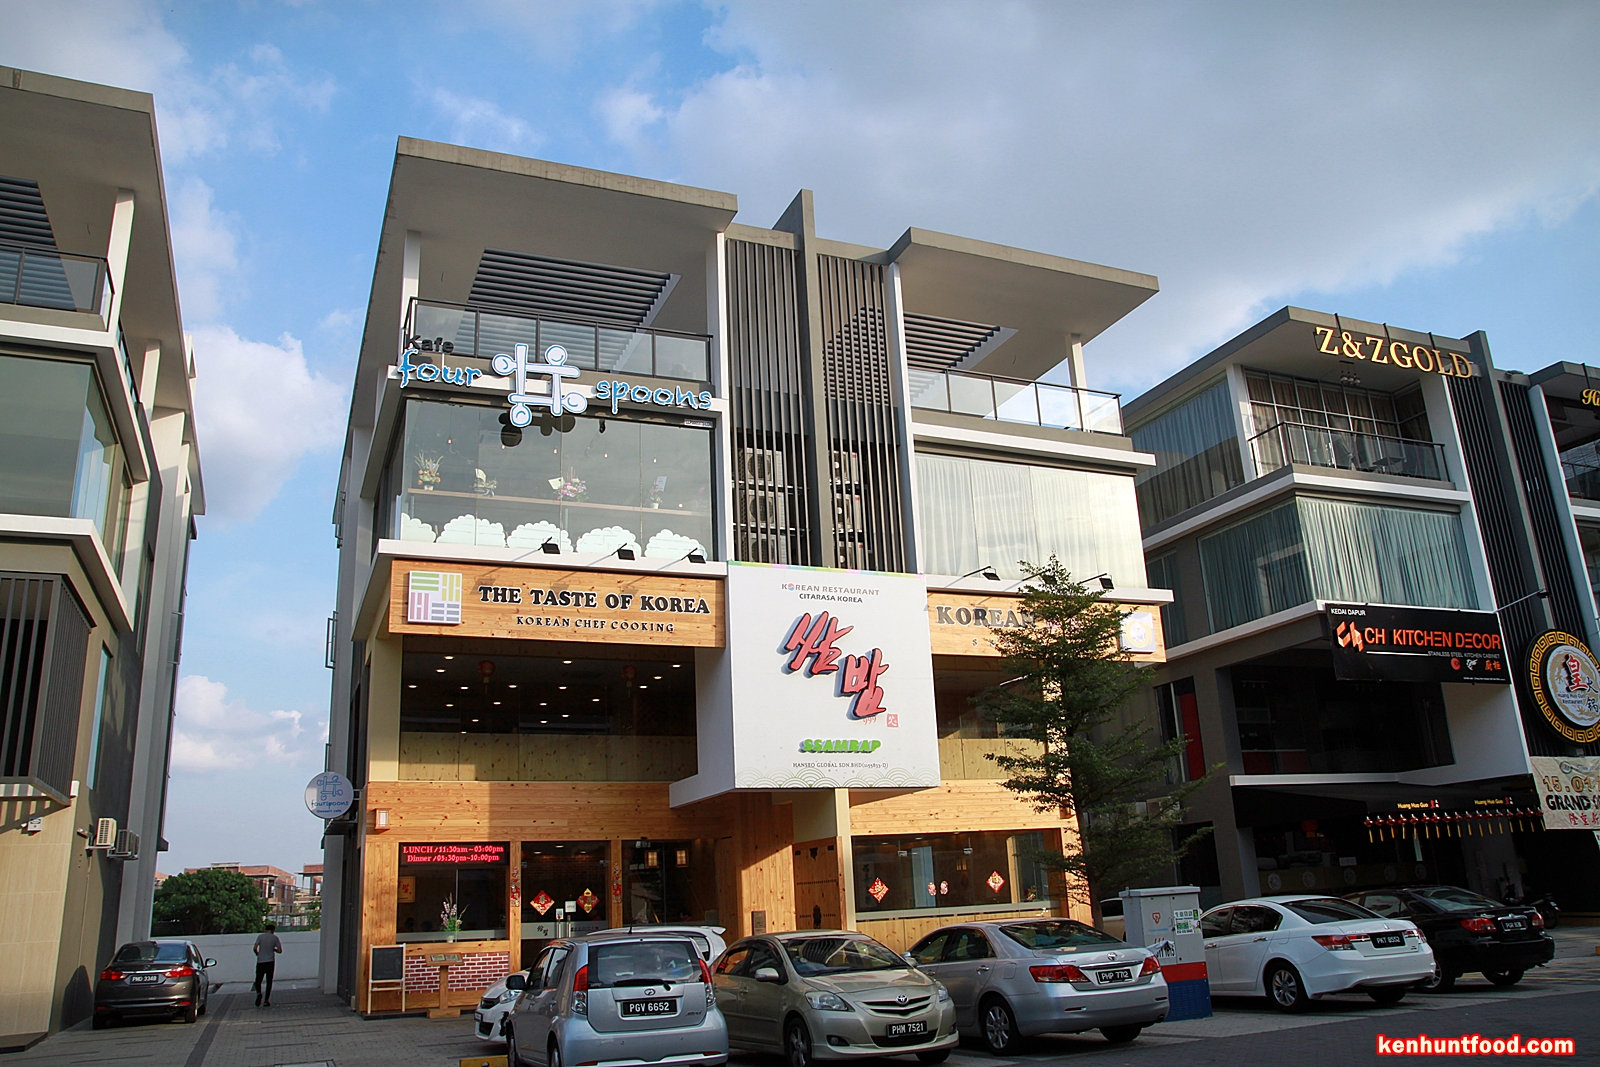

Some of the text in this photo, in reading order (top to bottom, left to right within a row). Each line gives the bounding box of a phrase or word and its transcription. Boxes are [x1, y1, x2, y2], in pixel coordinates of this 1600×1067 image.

[407, 334, 455, 353] Kafe
[398, 349, 713, 413] four spoons
[781, 583, 880, 596] KOREAN RESTAURANT
[478, 586, 711, 615] THE TASTE OF KOREA
[799, 593, 863, 603] CITARASA KOREA
[516, 616, 675, 632] KOREAN CHEF COOKING
[1365, 627, 1500, 649] CH KITCHEN DECOR
[800, 739, 881, 753] SSAMBAP
[1545, 794, 1591, 810] GRAND
[403, 846, 433, 854] LUNCH
[629, 1002, 669, 1012] PGV 6652
[907, 1022, 924, 1032] 7521
